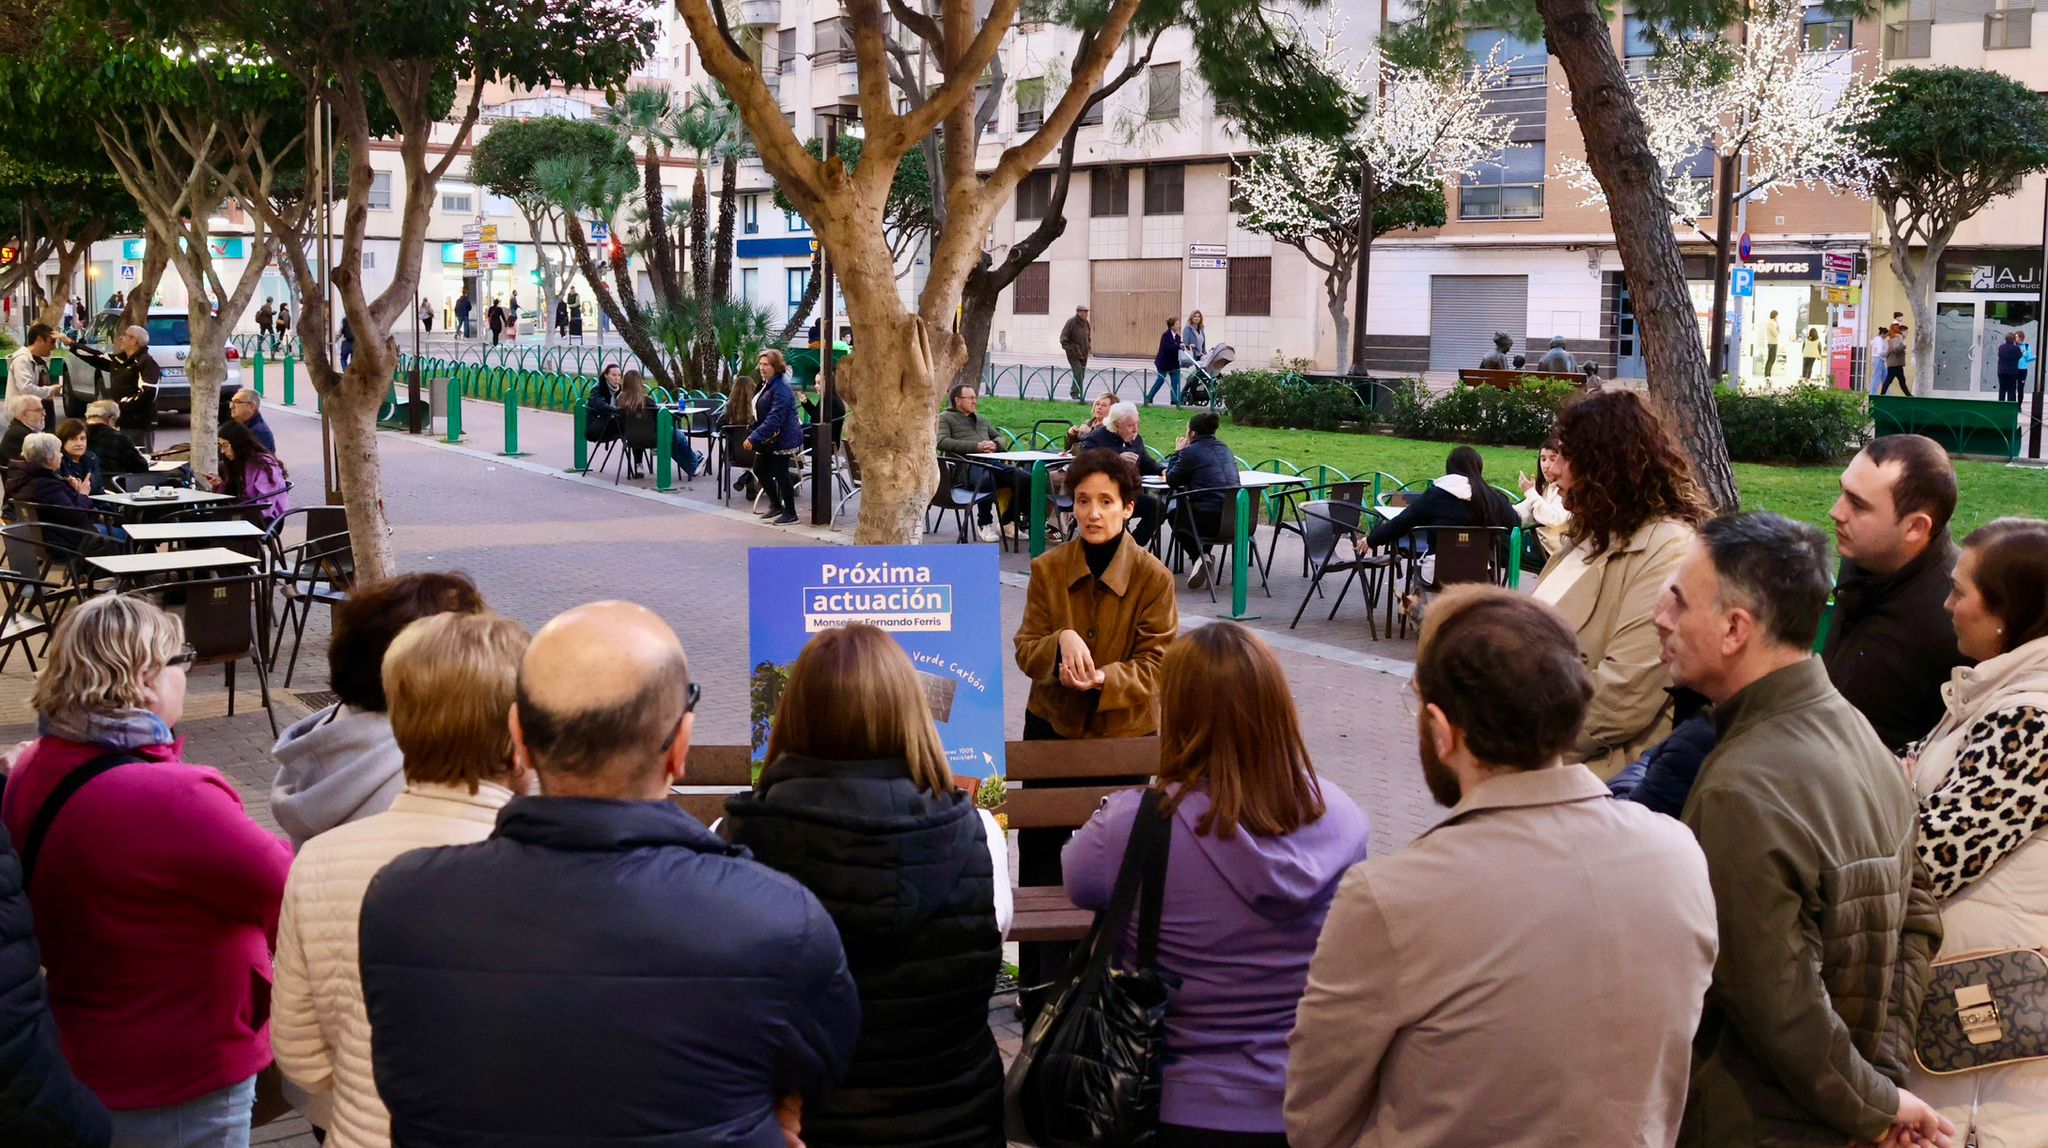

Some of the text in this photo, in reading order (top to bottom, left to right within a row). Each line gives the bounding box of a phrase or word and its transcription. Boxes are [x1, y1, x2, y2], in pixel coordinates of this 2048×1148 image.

[1736, 271, 1750, 293] P
[822, 562, 931, 584] Próxima
[813, 587, 942, 612] actuación
[865, 617, 912, 627] Fernando
[914, 617, 942, 627] Ferris
[912, 651, 985, 693] Verde Carbón
